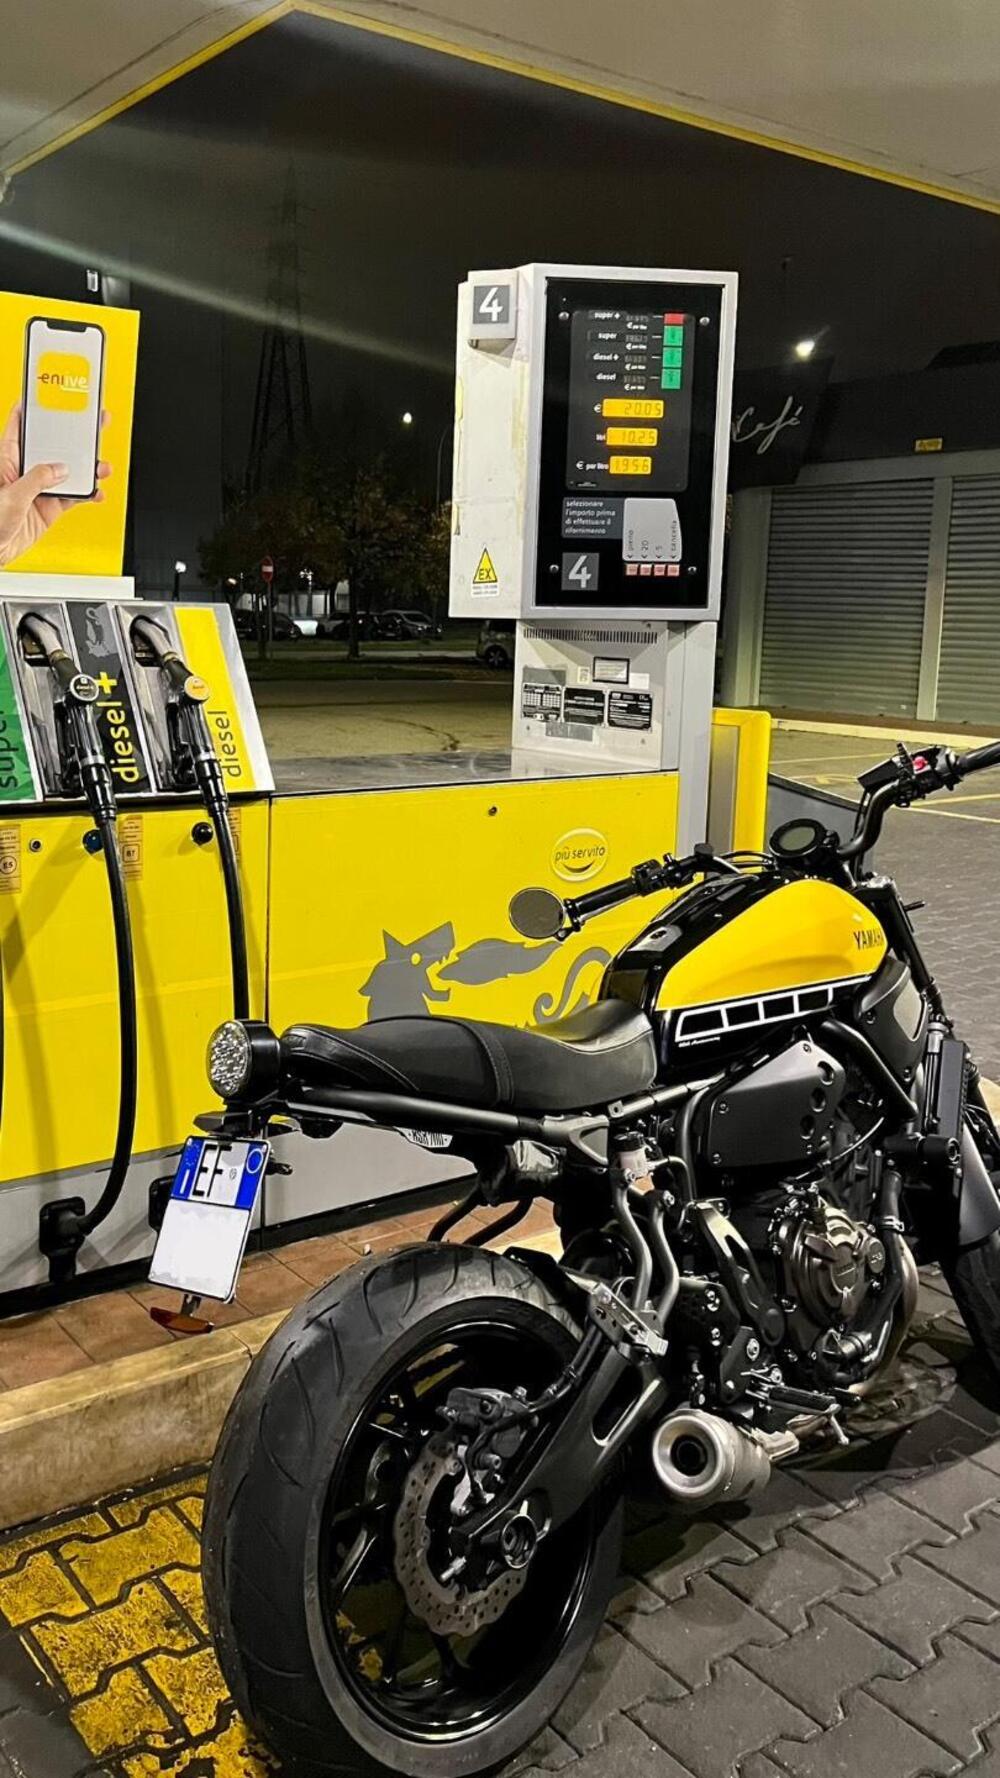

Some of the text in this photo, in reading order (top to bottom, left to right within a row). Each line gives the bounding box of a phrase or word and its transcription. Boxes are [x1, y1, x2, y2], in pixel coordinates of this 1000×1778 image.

[479, 287, 503, 322] 4
[573, 518, 605, 526] effettuare
[641, 540, 648, 551] 20
[478, 568, 493, 581] EX
[568, 554, 592, 589] 4
[96, 701, 140, 783] diesel
[207, 710, 242, 778] diesel
[554, 845, 606, 864] più servito
